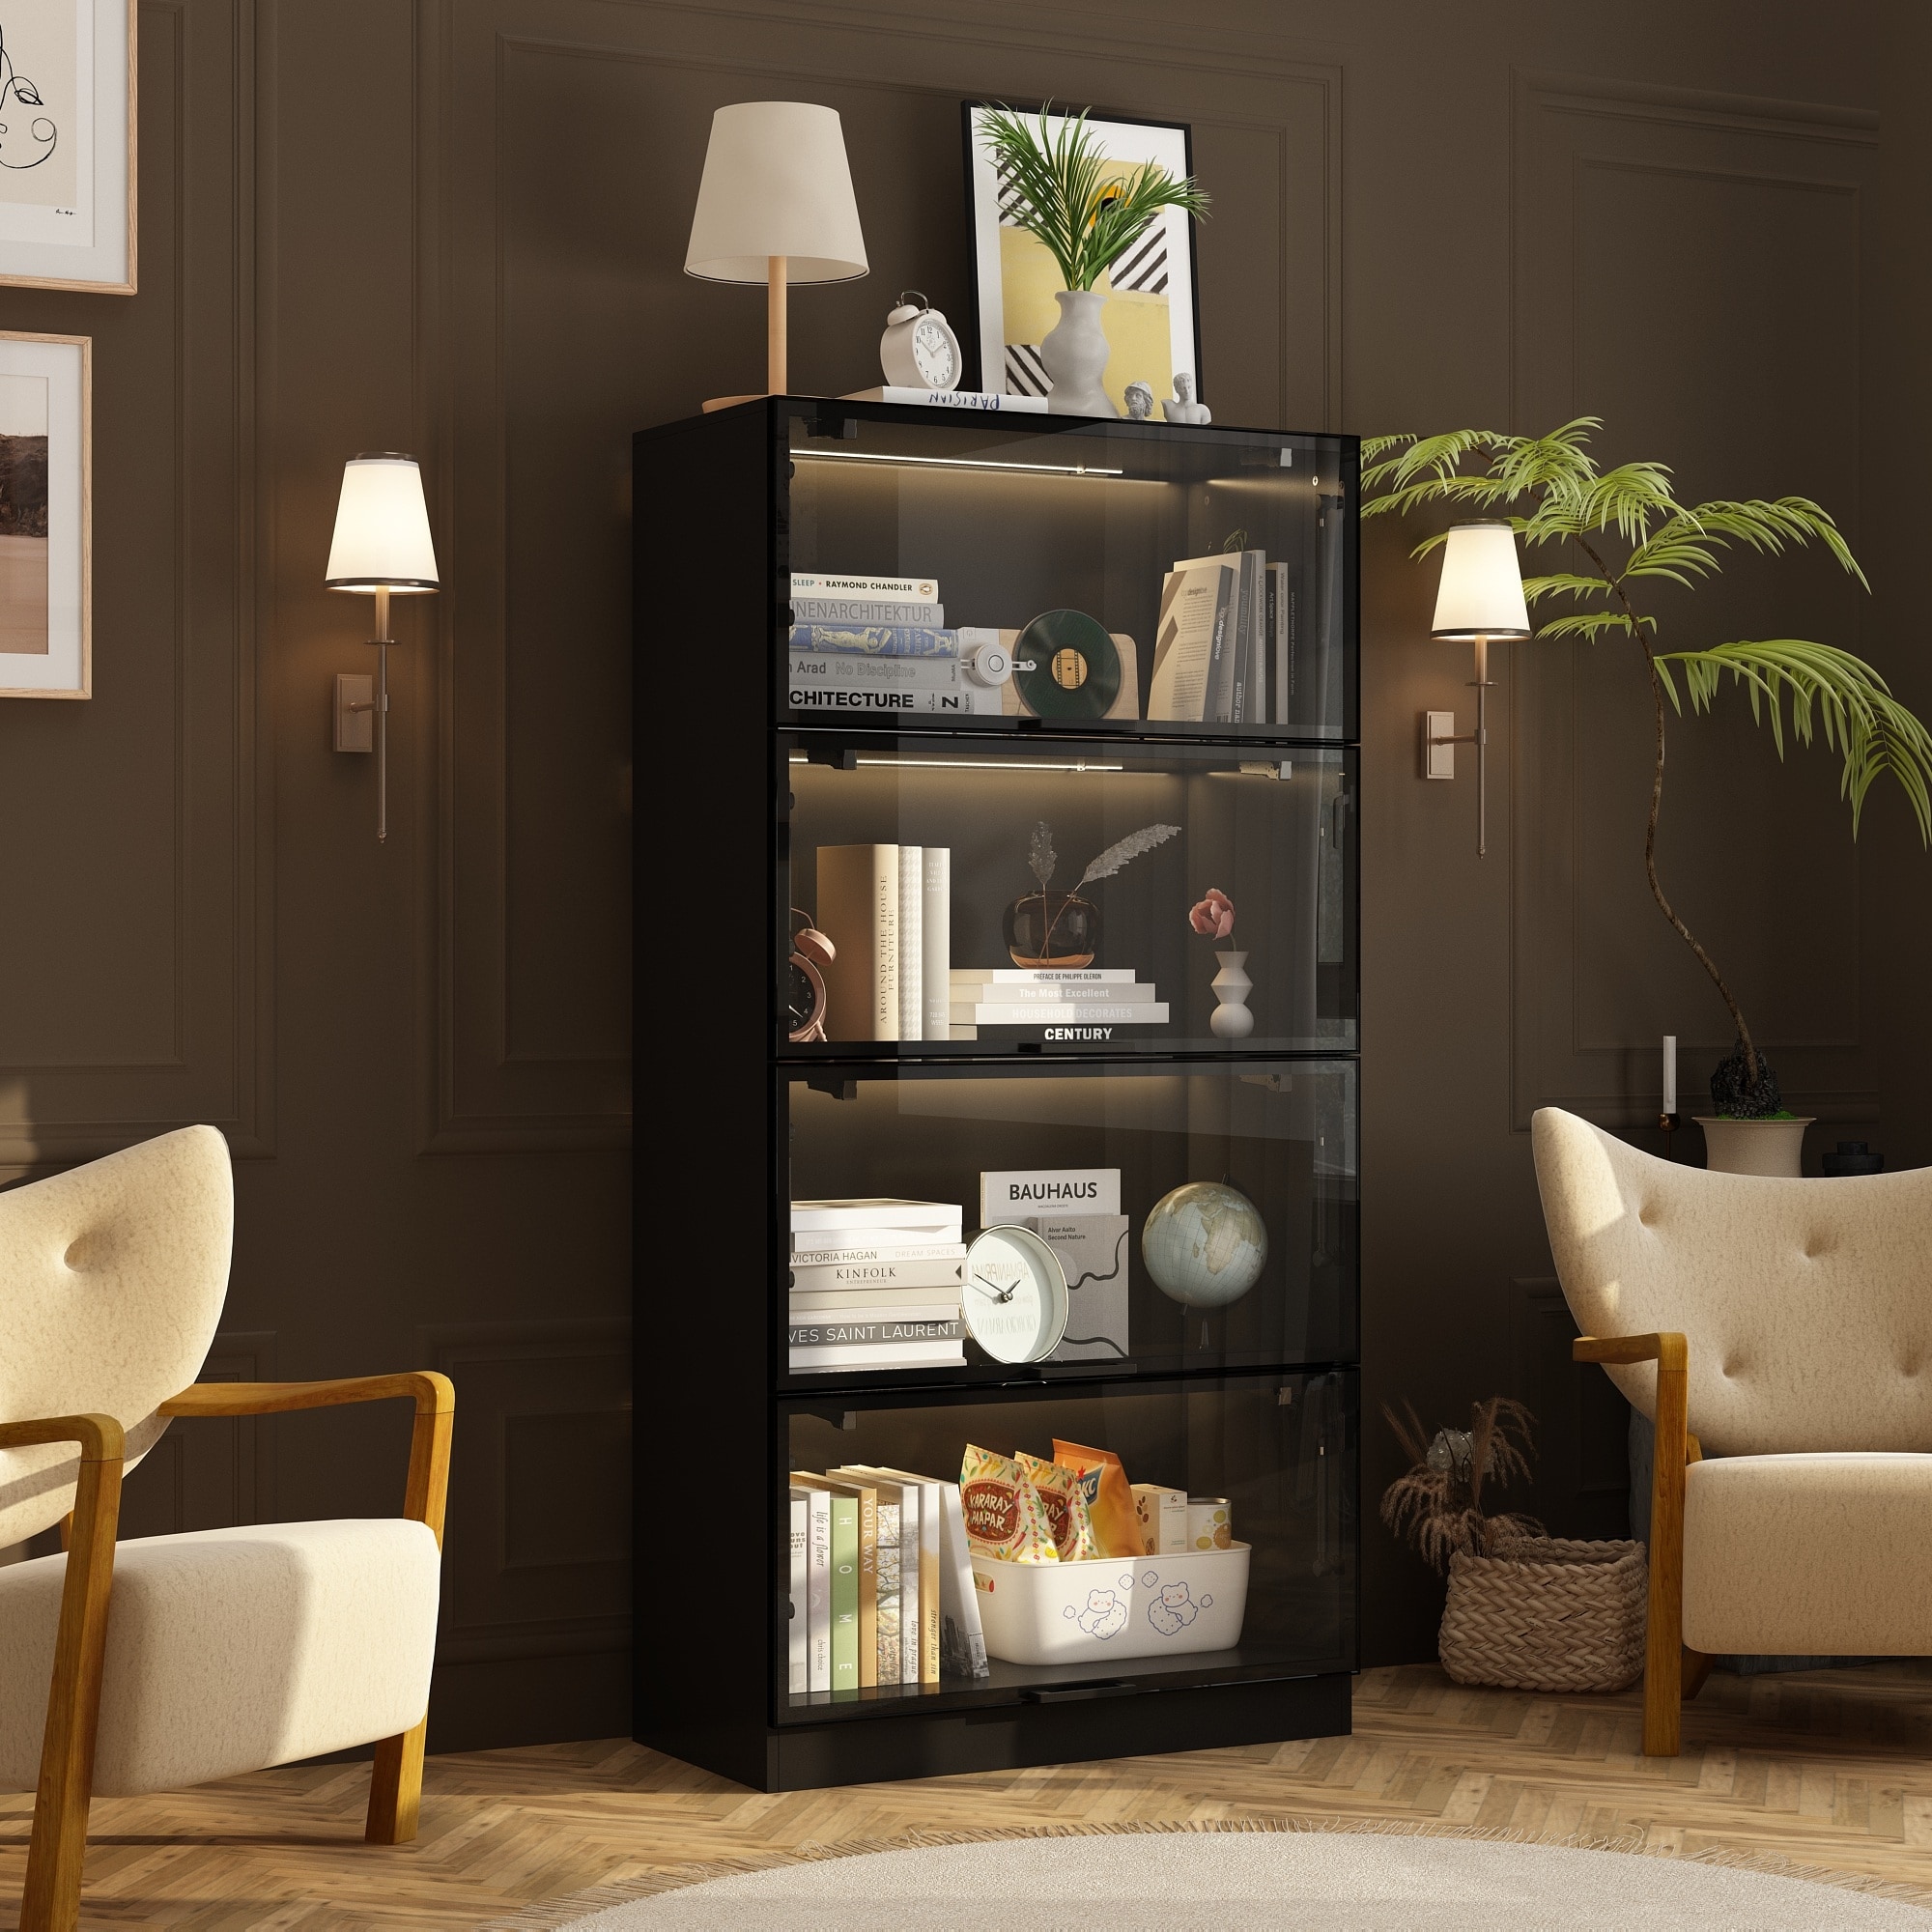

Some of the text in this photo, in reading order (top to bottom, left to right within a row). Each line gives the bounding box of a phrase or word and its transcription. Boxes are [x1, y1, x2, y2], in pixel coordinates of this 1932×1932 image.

[929, 392, 1000, 411] PARISIAN
[826, 581, 867, 589] RAYMOND
[870, 582, 913, 591] CHANDLER
[797, 661, 826, 674] Arad
[835, 661, 854, 675] No
[857, 663, 916, 679] Discipline
[790, 690, 914, 708] CHITECTURE
[1012, 1009, 1132, 1019] HOUSEHOLD DECORATES
[1044, 1028, 1113, 1039] CENTURY
[1009, 1182, 1097, 1200] BAUHAUS
[792, 1252, 839, 1264] VICTORIA
[843, 1251, 877, 1261] HAGAN
[837, 1267, 896, 1279] KINFOLK
[789, 1322, 959, 1343] VES SAINT LAURENT
[970, 1492, 1012, 1514] KARARAY
[812, 1511, 828, 1523] life
[971, 1510, 1005, 1531] PAAPAR
[864, 1497, 873, 1574] YOUR WAY
[812, 1542, 828, 1567] flower
[928, 1609, 938, 1640] stronger
[817, 1639, 826, 1671] chris choice
[930, 1643, 940, 1661] than
